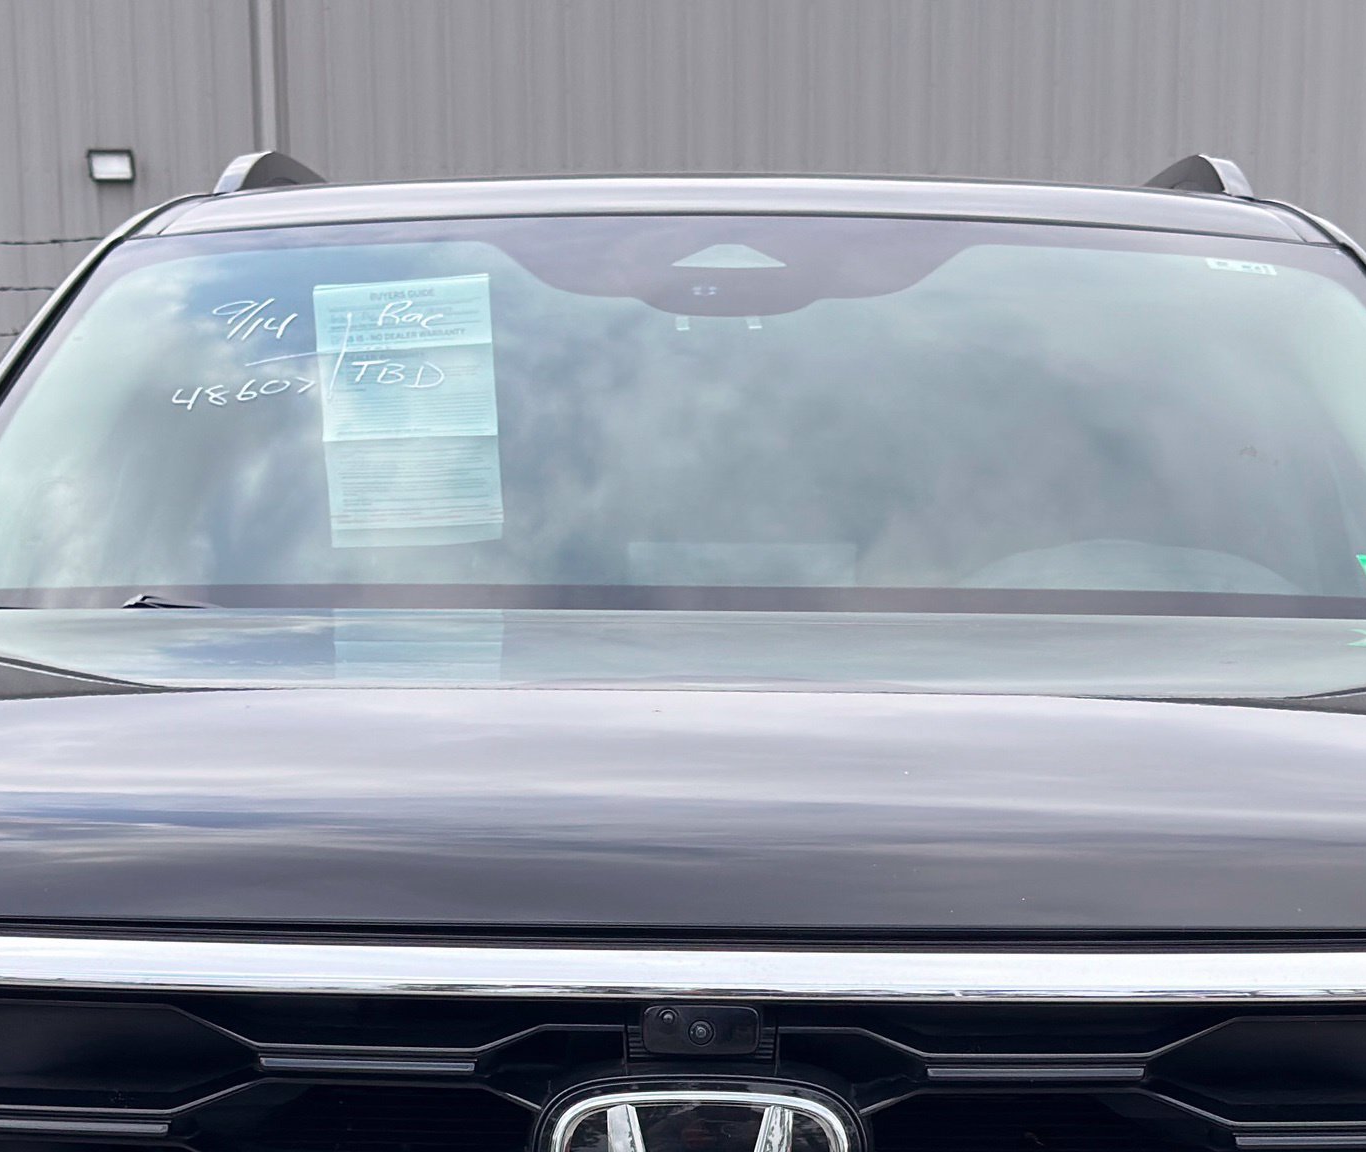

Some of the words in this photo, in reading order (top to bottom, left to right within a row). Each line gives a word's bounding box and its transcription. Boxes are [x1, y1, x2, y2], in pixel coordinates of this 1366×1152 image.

[212, 298, 298, 340] 9/14
[385, 330, 418, 340] DEALER
[420, 328, 466, 339] WARRANTY
[351, 358, 444, 388] TBD
